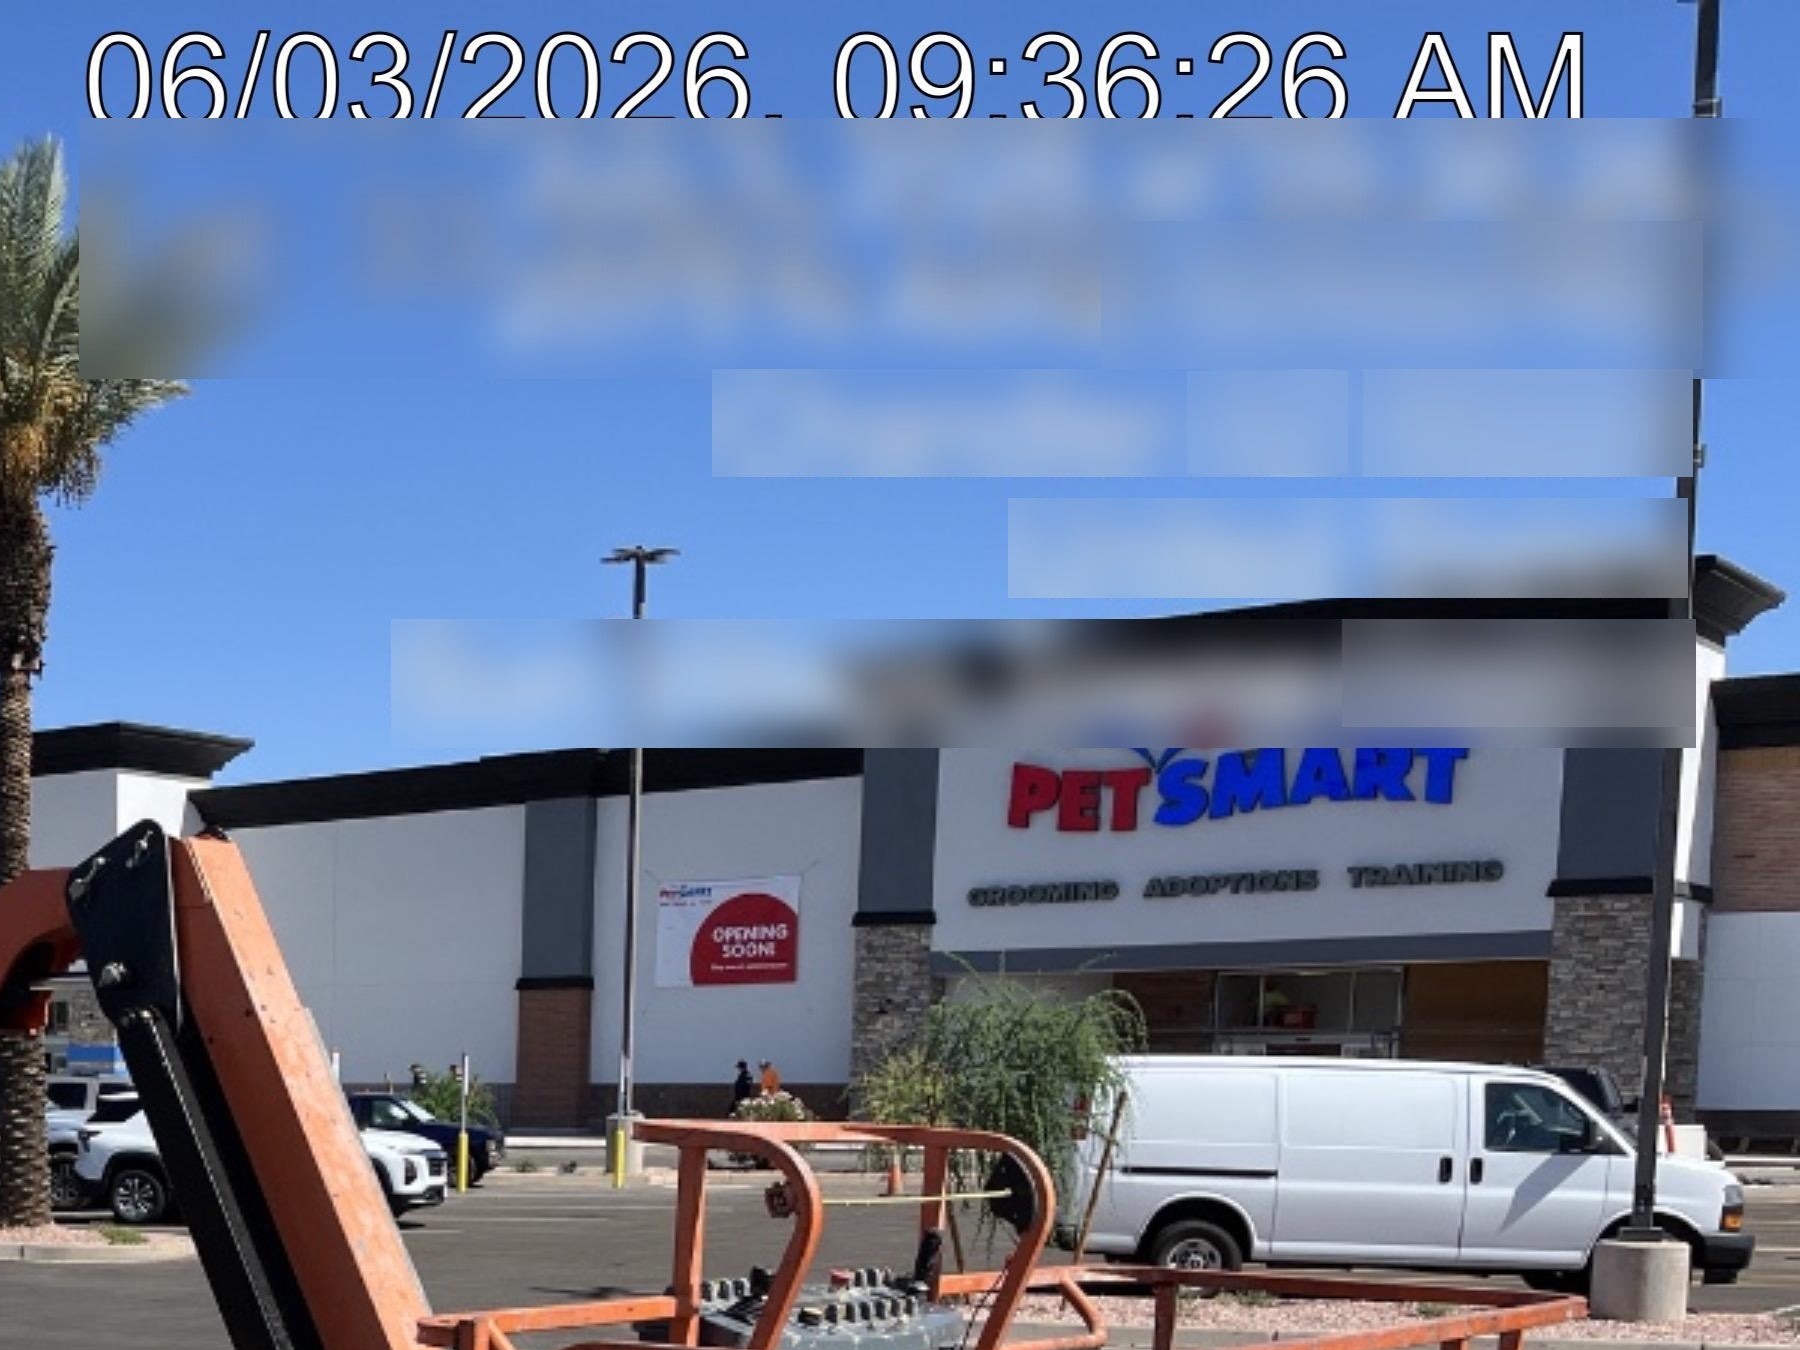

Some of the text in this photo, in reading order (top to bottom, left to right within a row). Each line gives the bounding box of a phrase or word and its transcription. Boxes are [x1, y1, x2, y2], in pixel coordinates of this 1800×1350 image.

[1007, 747, 1468, 832] PETSMART
[967, 859, 1504, 907] GROOMING ADOPTIONS TRAINING
[712, 923, 788, 943] OPENING
